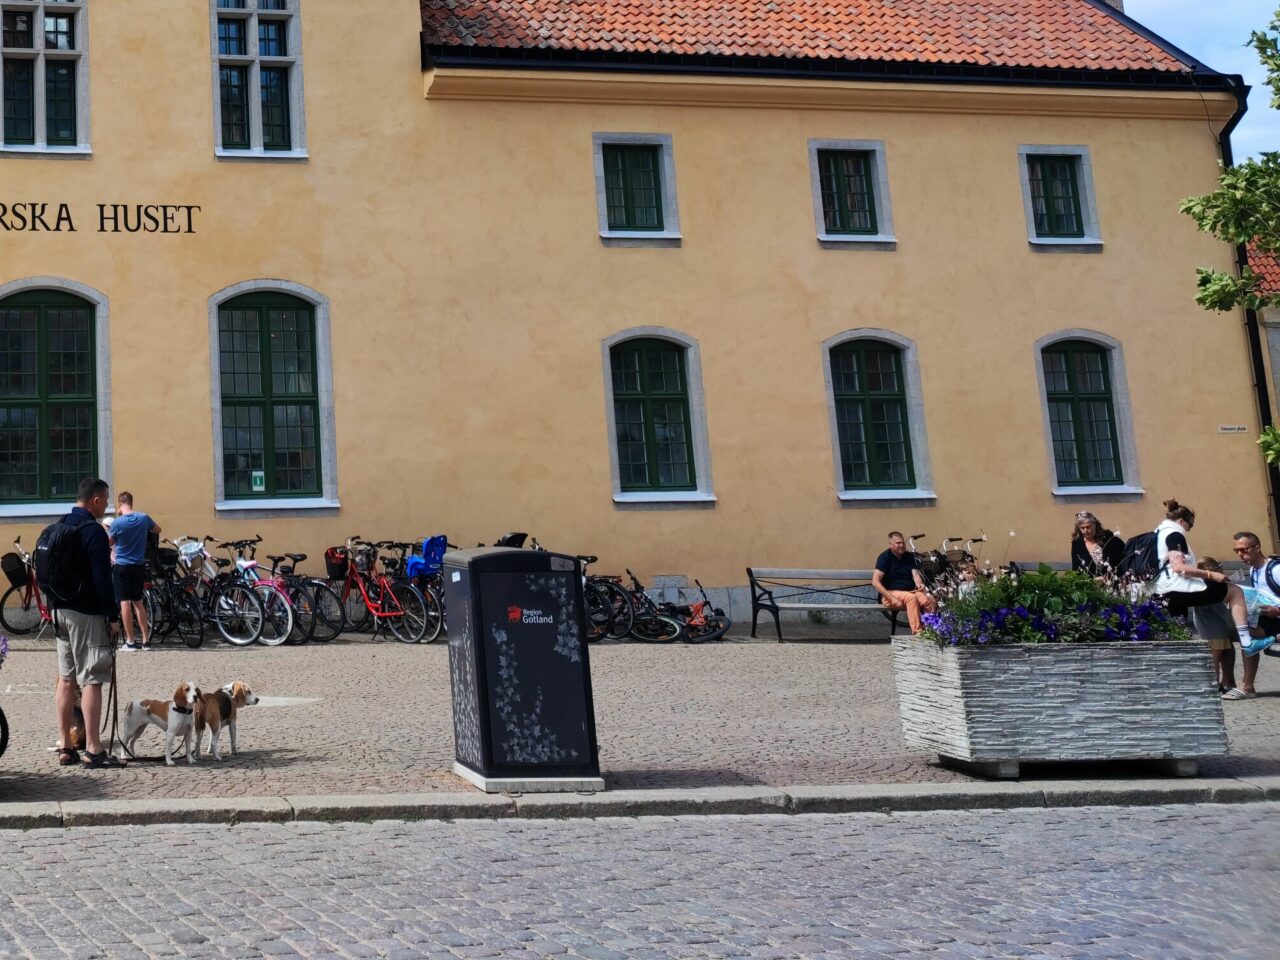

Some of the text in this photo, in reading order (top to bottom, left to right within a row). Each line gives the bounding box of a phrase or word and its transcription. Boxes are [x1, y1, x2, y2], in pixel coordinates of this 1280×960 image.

[96, 204, 201, 233] HUSET
[522, 608, 543, 617] Region
[522, 615, 553, 624] Gotland
